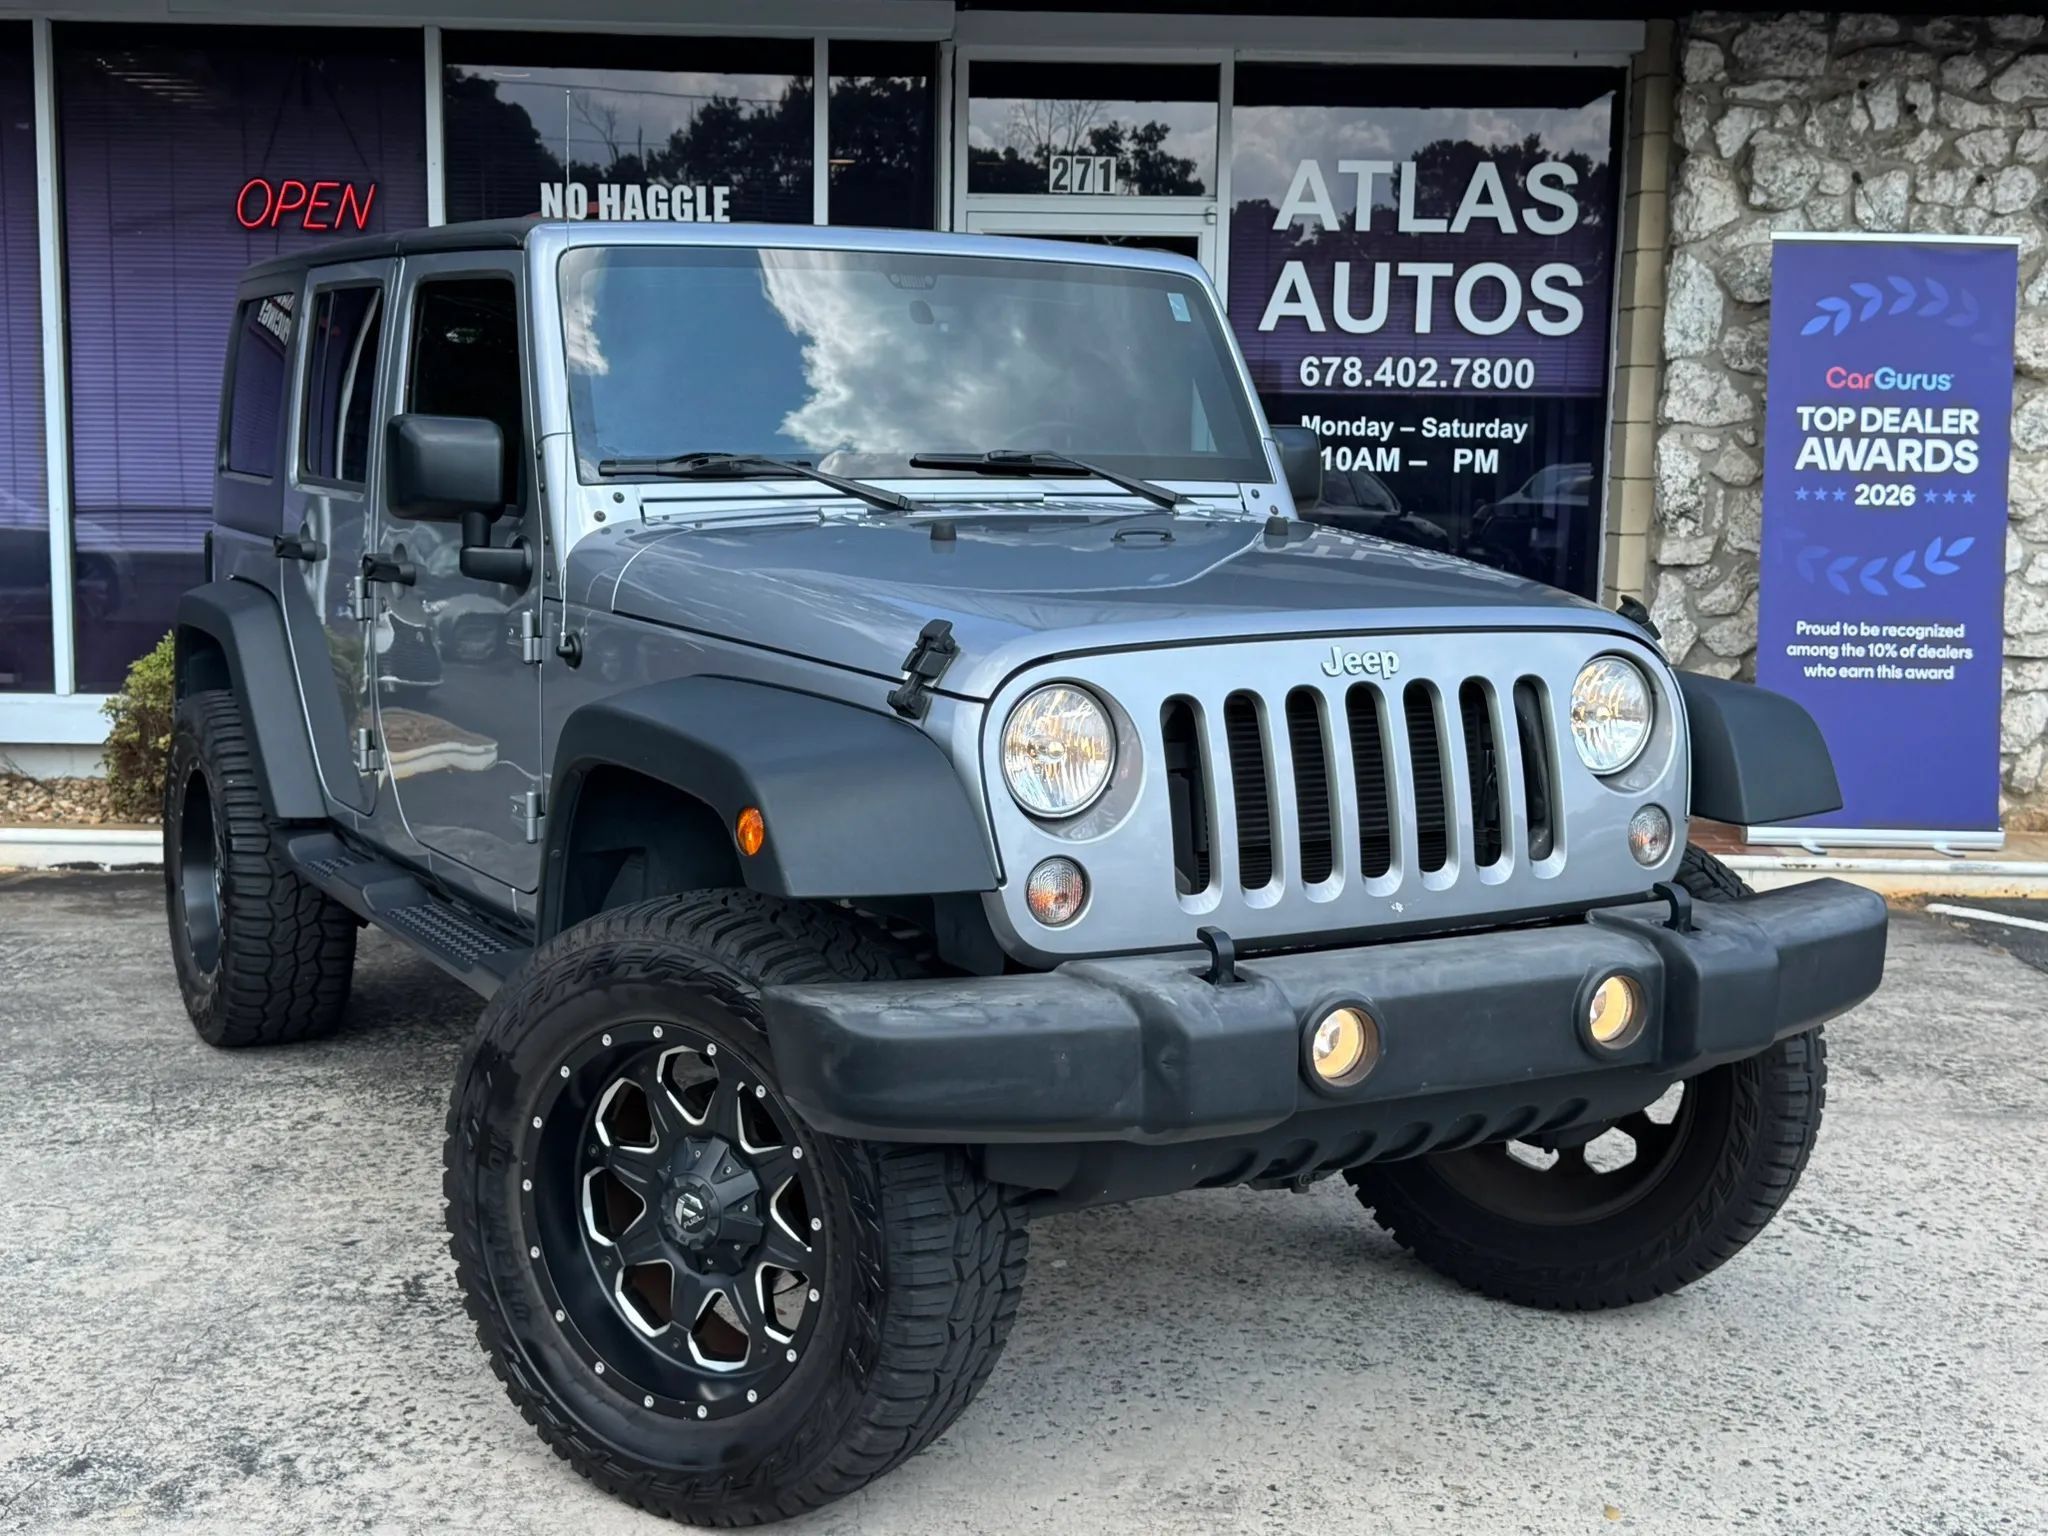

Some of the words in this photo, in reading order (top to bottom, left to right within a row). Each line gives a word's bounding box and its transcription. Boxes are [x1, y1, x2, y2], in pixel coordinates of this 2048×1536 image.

[1051, 157, 1112, 192] 271
[236, 178, 377, 230] OPEN
[540, 182, 588, 220] NO
[597, 183, 730, 222] HAGGLE
[1272, 159, 1580, 236] ATLAS
[1257, 260, 1585, 337] AUTOS
[1299, 356, 1536, 389] 678.402.7800
[1825, 366, 1952, 391] CarGurus
[1301, 415, 1395, 442] Monday
[1421, 416, 1528, 445] Saturday
[1796, 406, 1856, 432] TOP
[1860, 407, 1980, 435] DEALER
[1320, 446, 1400, 473] 10AM
[1453, 448, 1499, 474] PM
[1794, 436, 1980, 474] AWARDS
[1854, 483, 1917, 507] 2026
[1796, 620, 1841, 636] Proud
[1843, 622, 1858, 636] to
[1860, 622, 1881, 637] be
[1882, 623, 1965, 640] recognized
[1320, 645, 1400, 680] Jeep
[1786, 644, 1839, 659] among
[1841, 643, 1866, 657] the
[1867, 643, 1898, 658] 10%
[1900, 644, 1917, 659] of
[1917, 645, 1974, 660] dealers
[1803, 663, 1837, 678] who
[1838, 666, 1875, 678] earn
[1876, 664, 1903, 679] this
[1904, 665, 1955, 680] award
